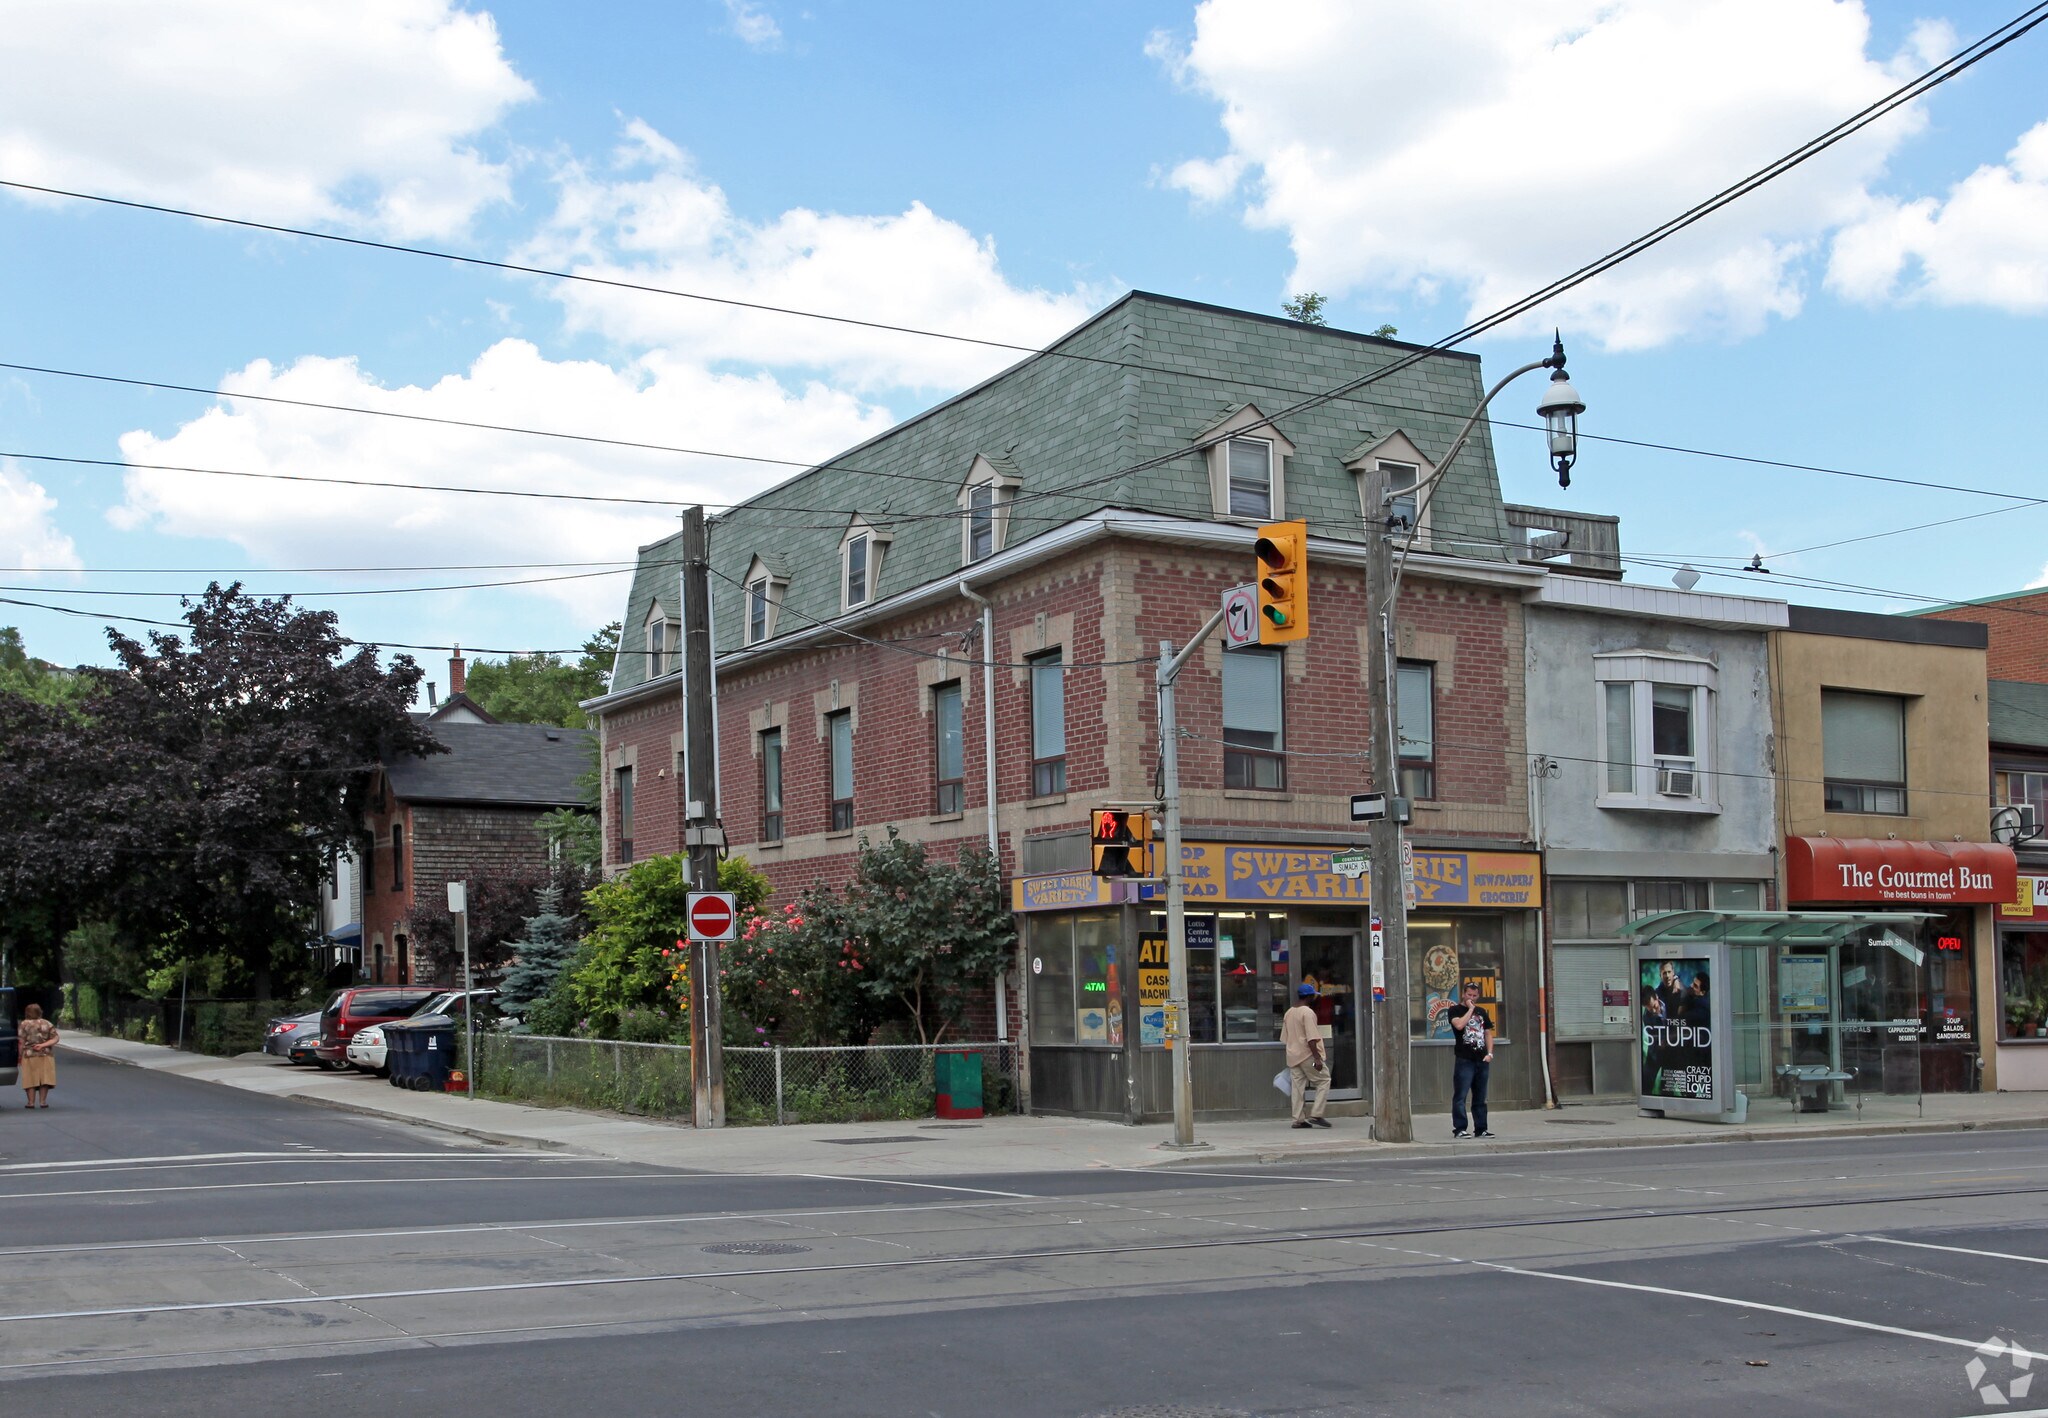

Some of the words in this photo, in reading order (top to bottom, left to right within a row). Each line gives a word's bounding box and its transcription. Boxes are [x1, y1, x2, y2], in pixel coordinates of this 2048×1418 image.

[1181, 847, 1205, 860] OP
[1231, 851, 1331, 881] SWEE
[1413, 856, 1462, 887] RIE
[1338, 862, 1359, 872] SUMACH
[1473, 874, 1534, 887] NEWSPAPERS
[1838, 863, 1873, 888] The
[1878, 864, 1954, 889] Gourmet
[1959, 866, 1993, 890] Bun
[1027, 878, 1059, 897] SWEET
[1060, 875, 1093, 893] MARIE
[1155, 883, 1219, 896] BEAD
[1257, 873, 1441, 899] VARIY
[1032, 889, 1088, 905] VARIETY
[1479, 891, 1530, 904] GROCERIES
[1895, 890, 1909, 899] best
[1910, 890, 1927, 900] buns
[1928, 891, 1935, 900] in
[1187, 920, 1206, 928] Lotto
[1187, 928, 1210, 936] Centre
[1187, 936, 1196, 944] de
[1868, 938, 1894, 947] Sumach
[1938, 937, 1961, 950] OPEN
[1139, 940, 1168, 963] AT
[1084, 982, 1106, 992] ATM
[1140, 989, 1170, 999] MACHI
[1666, 1018, 1679, 1026] THIS
[1680, 1018, 1687, 1026] IS
[1841, 1025, 1872, 1033] SPECALS
[1643, 1025, 1712, 1048] STUPID
[1936, 1032, 1971, 1040] SANDWICHES
[1686, 1065, 1711, 1075] CRAZY
[1686, 1074, 1712, 1083] STUPID
[1686, 1083, 1711, 1094] LOVE
